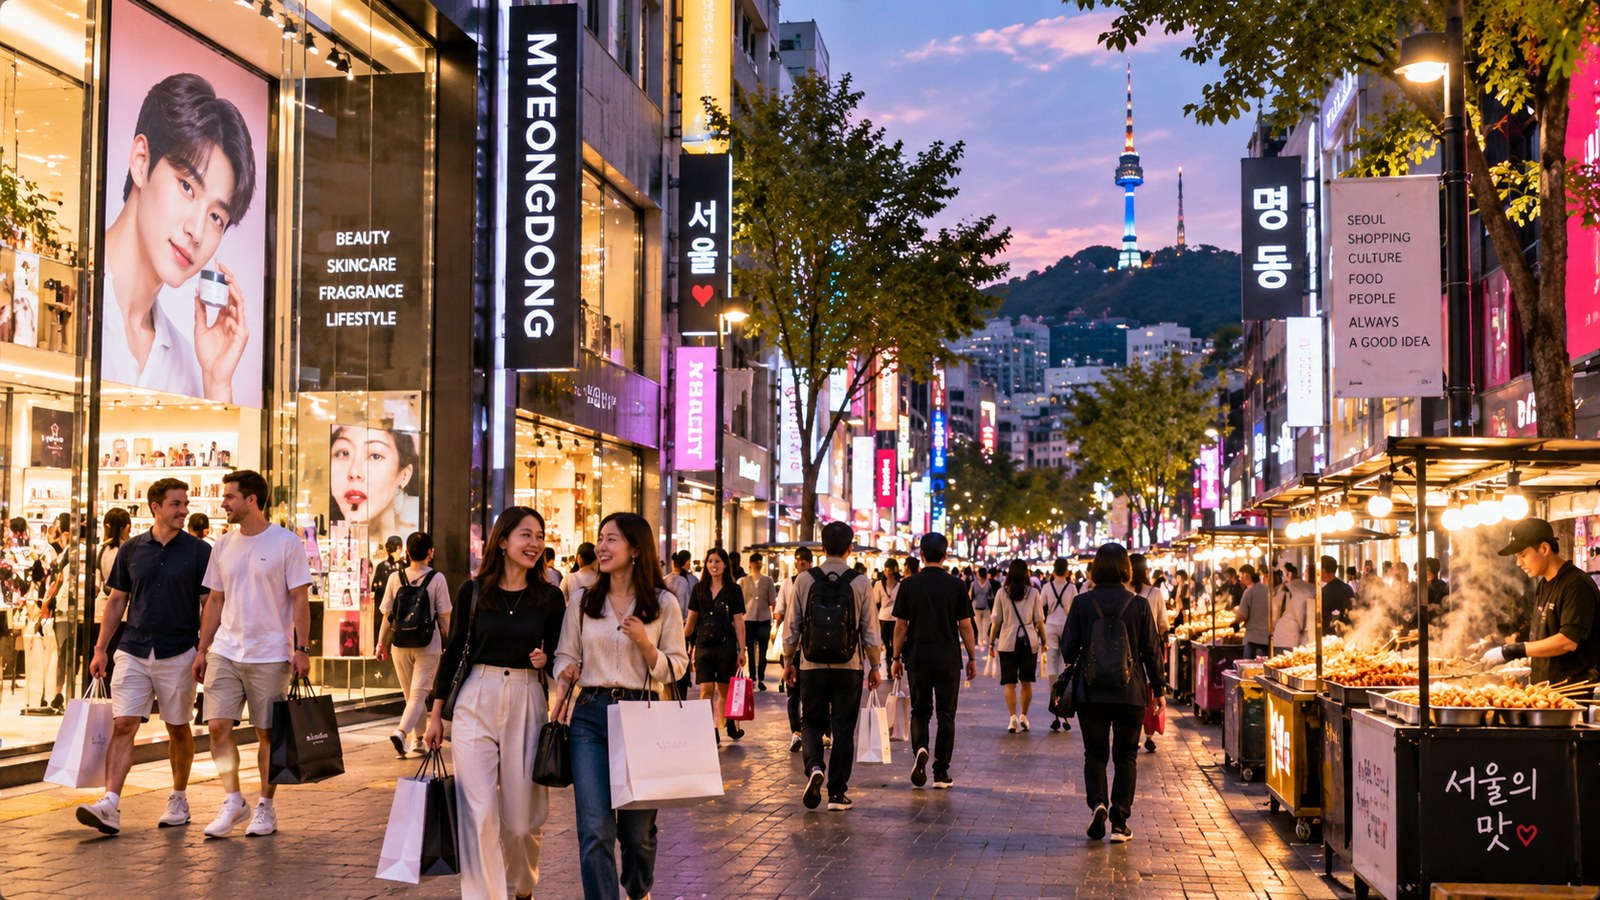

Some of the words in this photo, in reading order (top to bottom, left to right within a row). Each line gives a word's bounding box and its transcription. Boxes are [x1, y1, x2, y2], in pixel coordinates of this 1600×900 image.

[523, 33, 558, 338] MYEONGDONG
[1347, 214, 1386, 226] SEOUL
[336, 230, 391, 246] BEAUTY
[687, 200, 718, 274] 서울
[1252, 185, 1292, 289] 명동
[1348, 232, 1411, 244] SHOPPING
[327, 257, 397, 273] SKINCARE
[1348, 252, 1403, 264] CULTURE
[1348, 273, 1384, 285] FOOD
[319, 284, 404, 300] FRAGRANCE
[1349, 293, 1396, 305] PEOPLE
[326, 311, 397, 327] LIFESTYLE
[1349, 316, 1400, 328] ALWAYS
[1349, 337, 1358, 349] A
[1361, 336, 1398, 348] GOOD
[1445, 762, 1537, 806] 서울의
[1477, 811, 1513, 852] 맛
